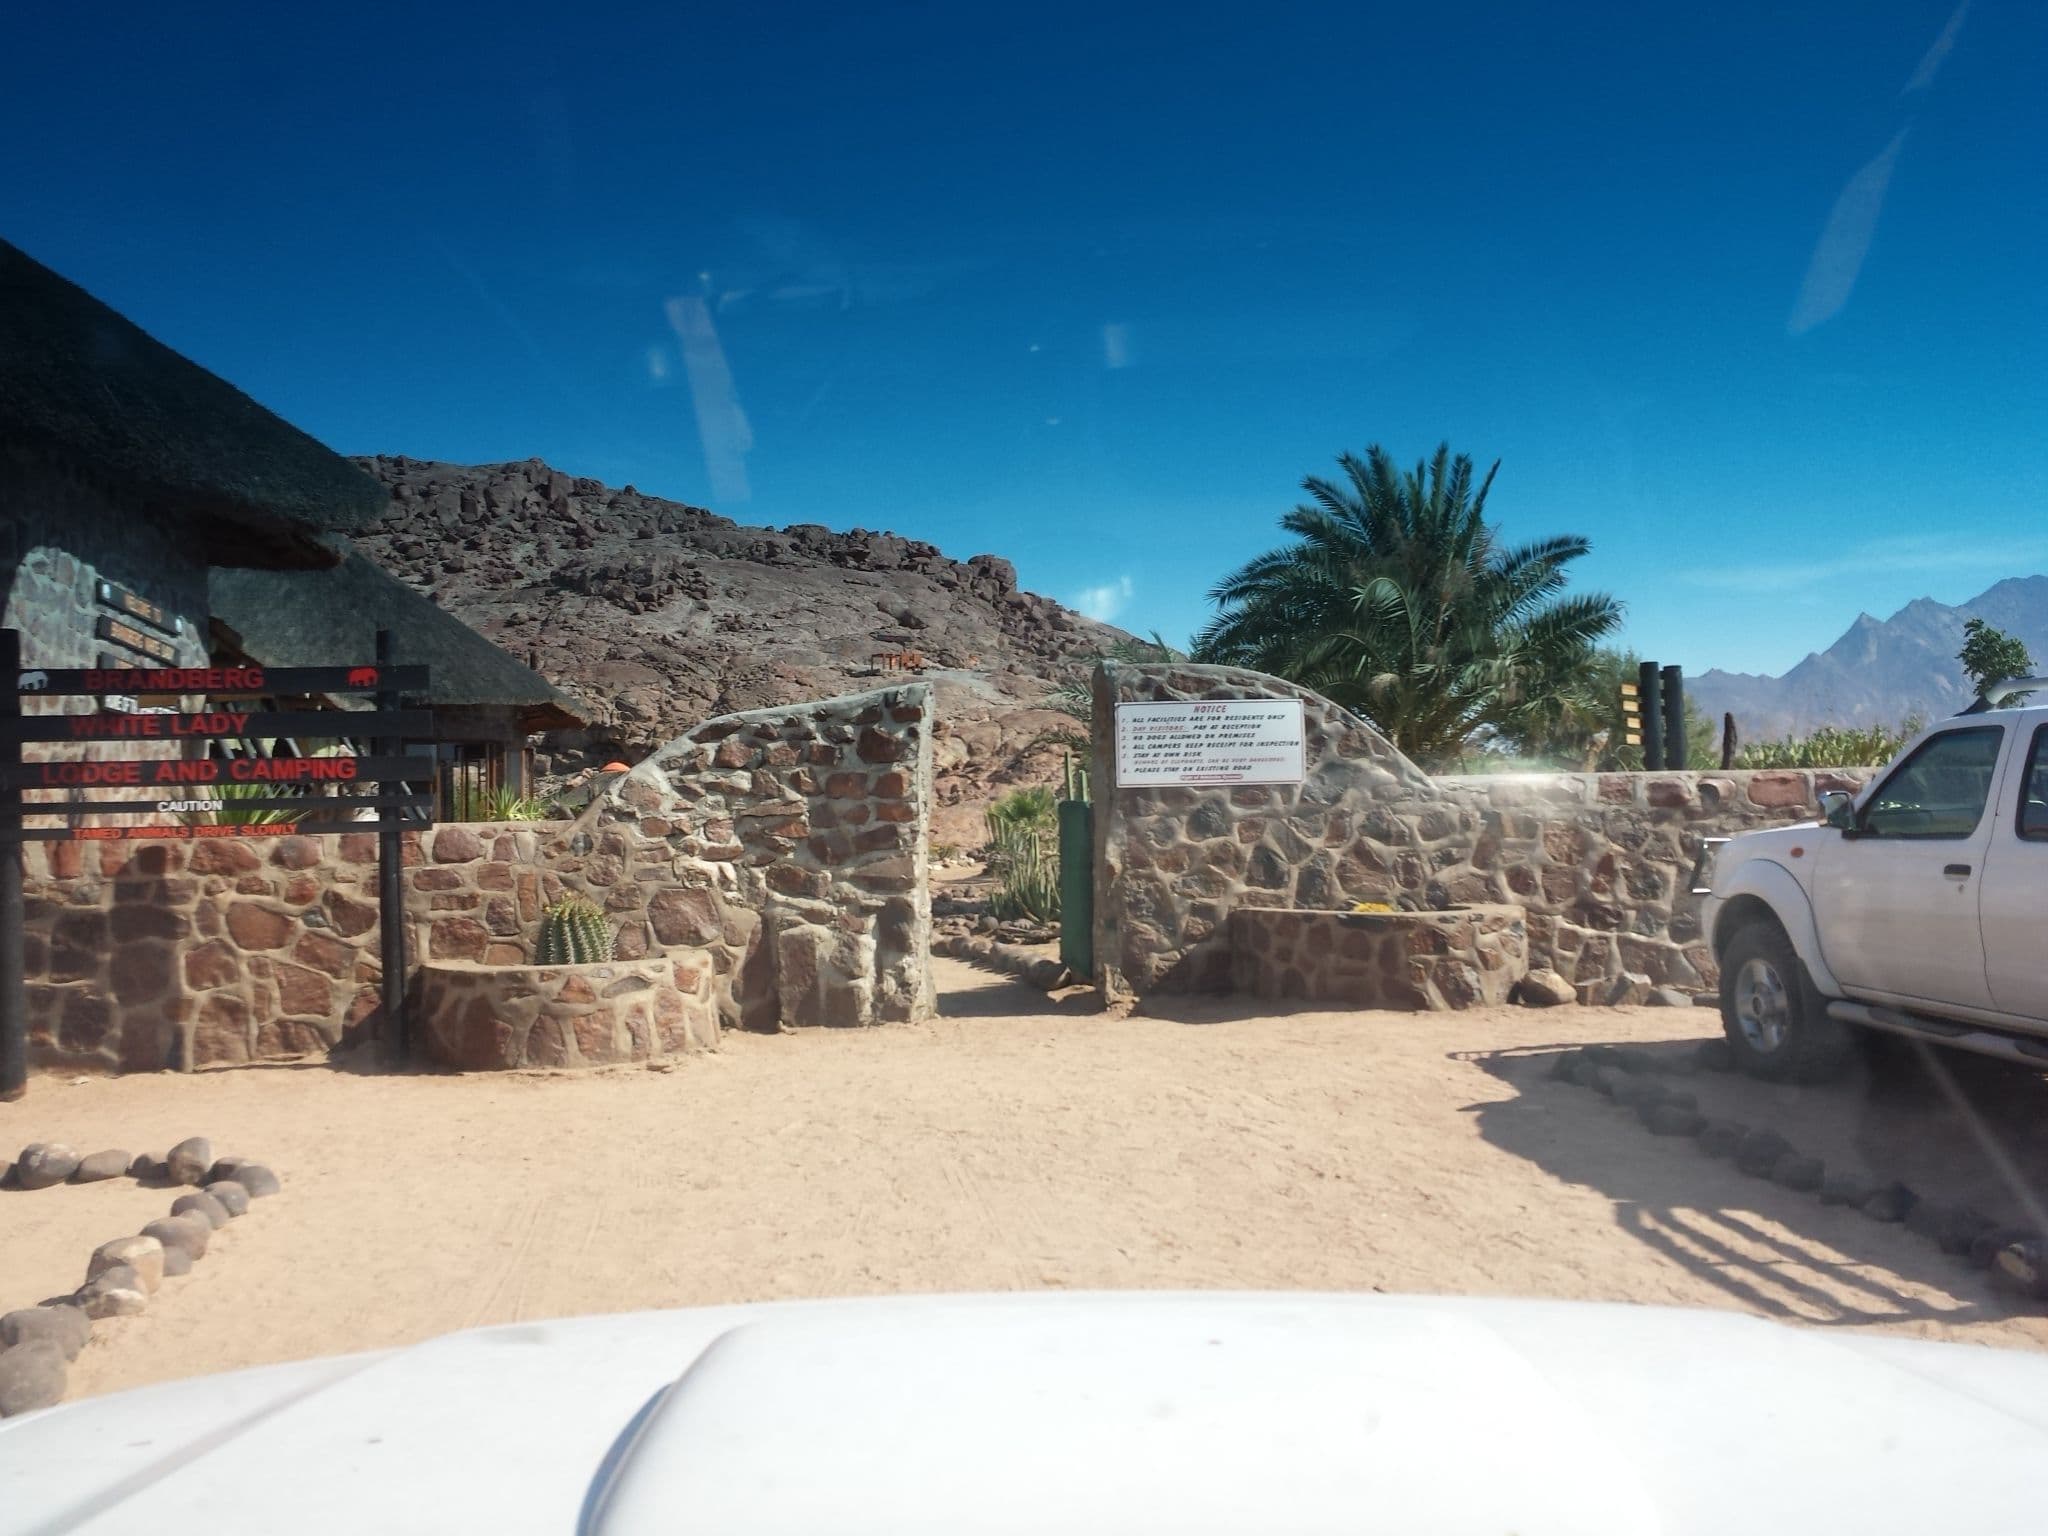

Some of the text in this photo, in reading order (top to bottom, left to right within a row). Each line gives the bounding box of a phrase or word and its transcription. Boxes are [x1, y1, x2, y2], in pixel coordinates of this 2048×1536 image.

[84, 667, 265, 690] BRANDBERG
[1193, 705, 1227, 713] NOTICE
[70, 713, 249, 737] WHITE LADY
[41, 757, 357, 784] LODGE AND CAMPING
[156, 799, 223, 813] CAUTION
[72, 823, 297, 840] TAMED ANIMALS DRIVE SLOWLY
